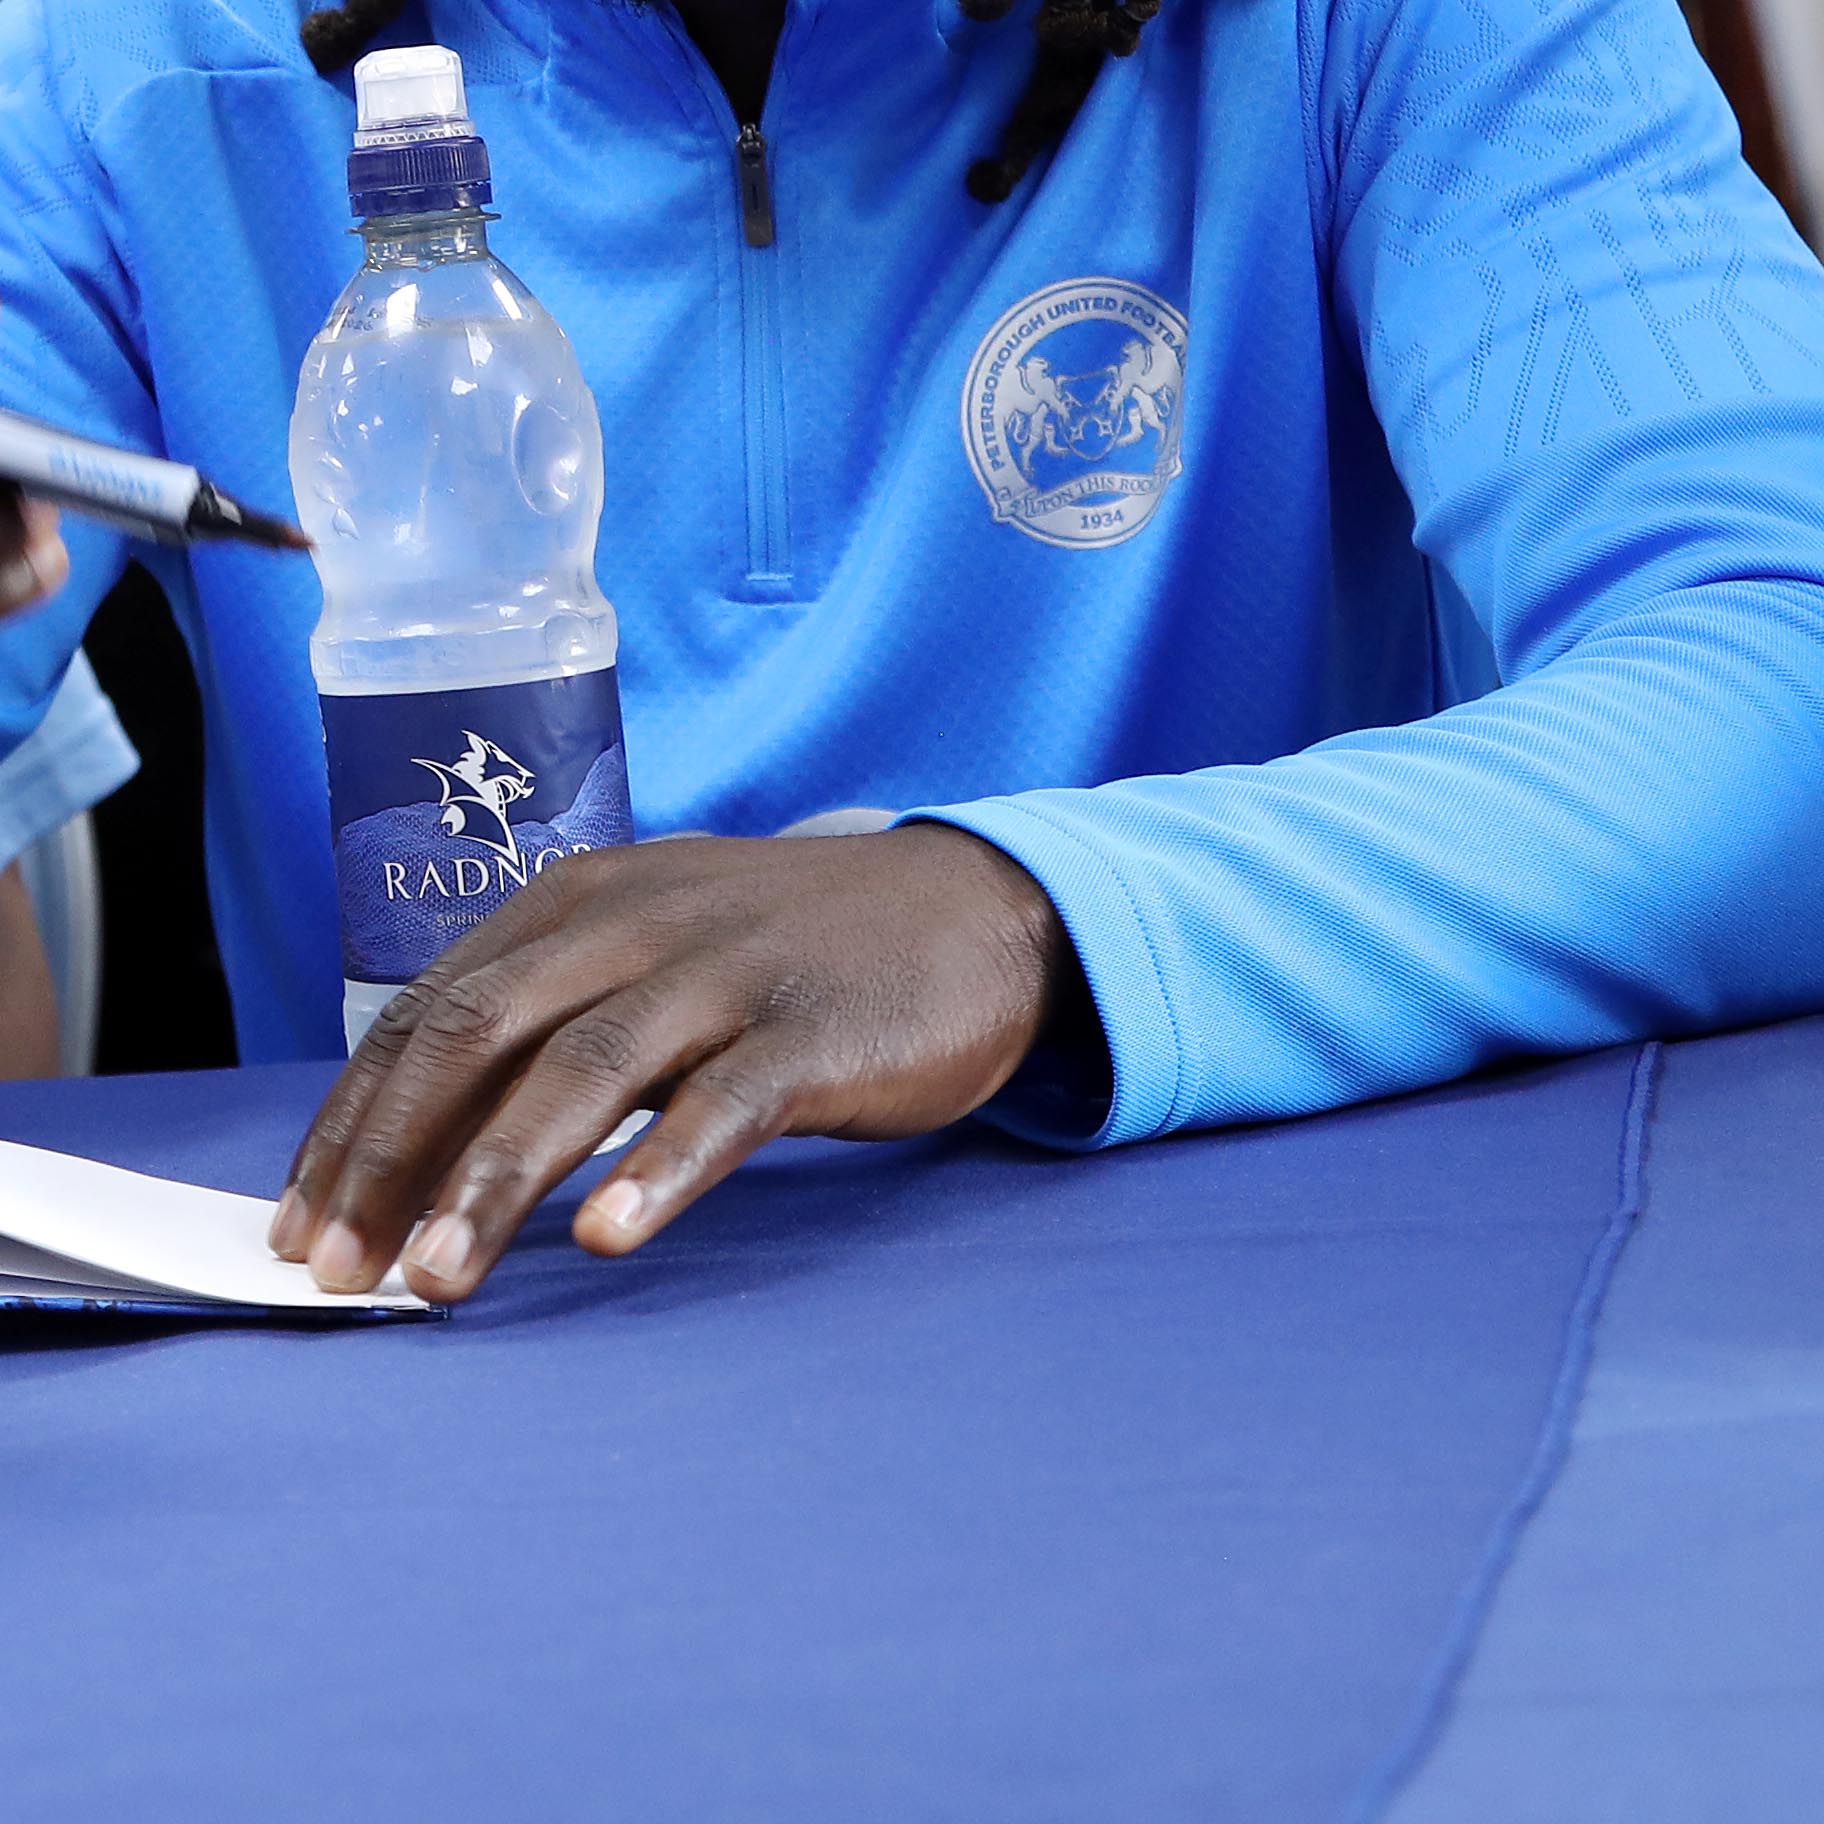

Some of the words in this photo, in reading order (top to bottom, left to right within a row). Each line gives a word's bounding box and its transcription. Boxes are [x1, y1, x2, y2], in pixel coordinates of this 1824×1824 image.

[981, 313, 1045, 472] PETERBOROUGH
[1047, 297, 1118, 320] UNITED
[1120, 301, 1186, 362] FOOTBA
[1075, 476, 1115, 495] THIS
[1119, 478, 1155, 493] ROC
[1080, 511, 1123, 530] 1934
[436, 912, 489, 928] SPRIN
